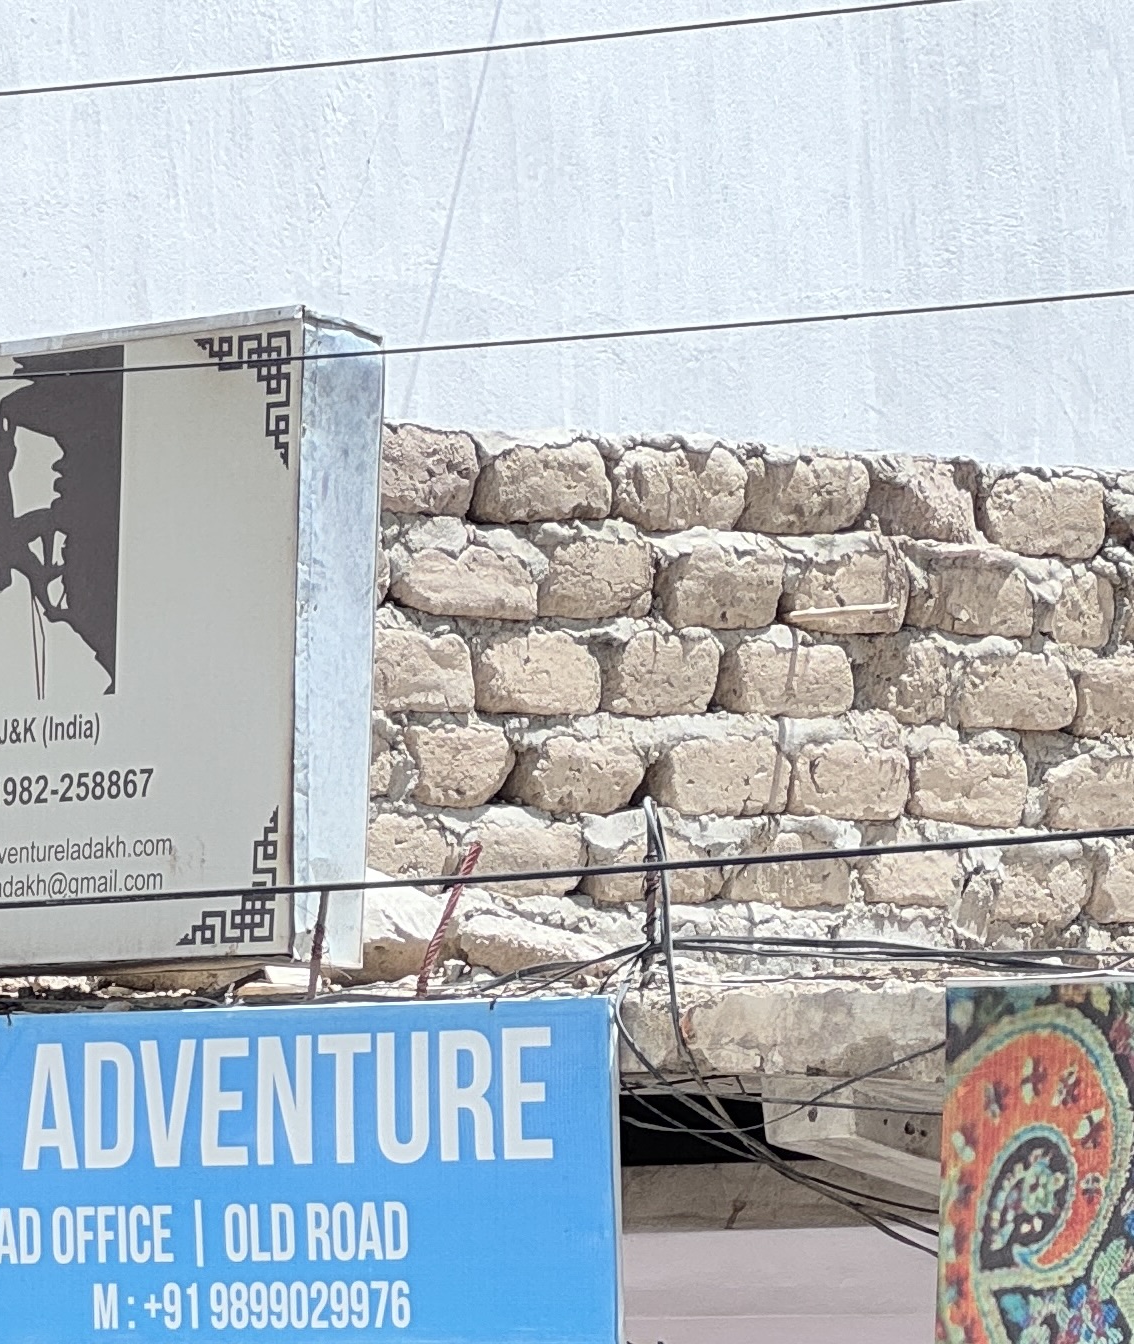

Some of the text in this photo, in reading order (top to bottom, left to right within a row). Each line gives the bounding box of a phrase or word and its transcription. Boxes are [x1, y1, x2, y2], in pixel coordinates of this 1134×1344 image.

[43, 712, 100, 748] (India)
[22, 1026, 554, 1171] ADVENTURE
[51, 1205, 174, 1265] OFFICE
[224, 1203, 296, 1263] OLD
[305, 1201, 409, 1262] ROAD
[143, 1282, 199, 1330] +91
[209, 1280, 411, 1330] 9899029976
